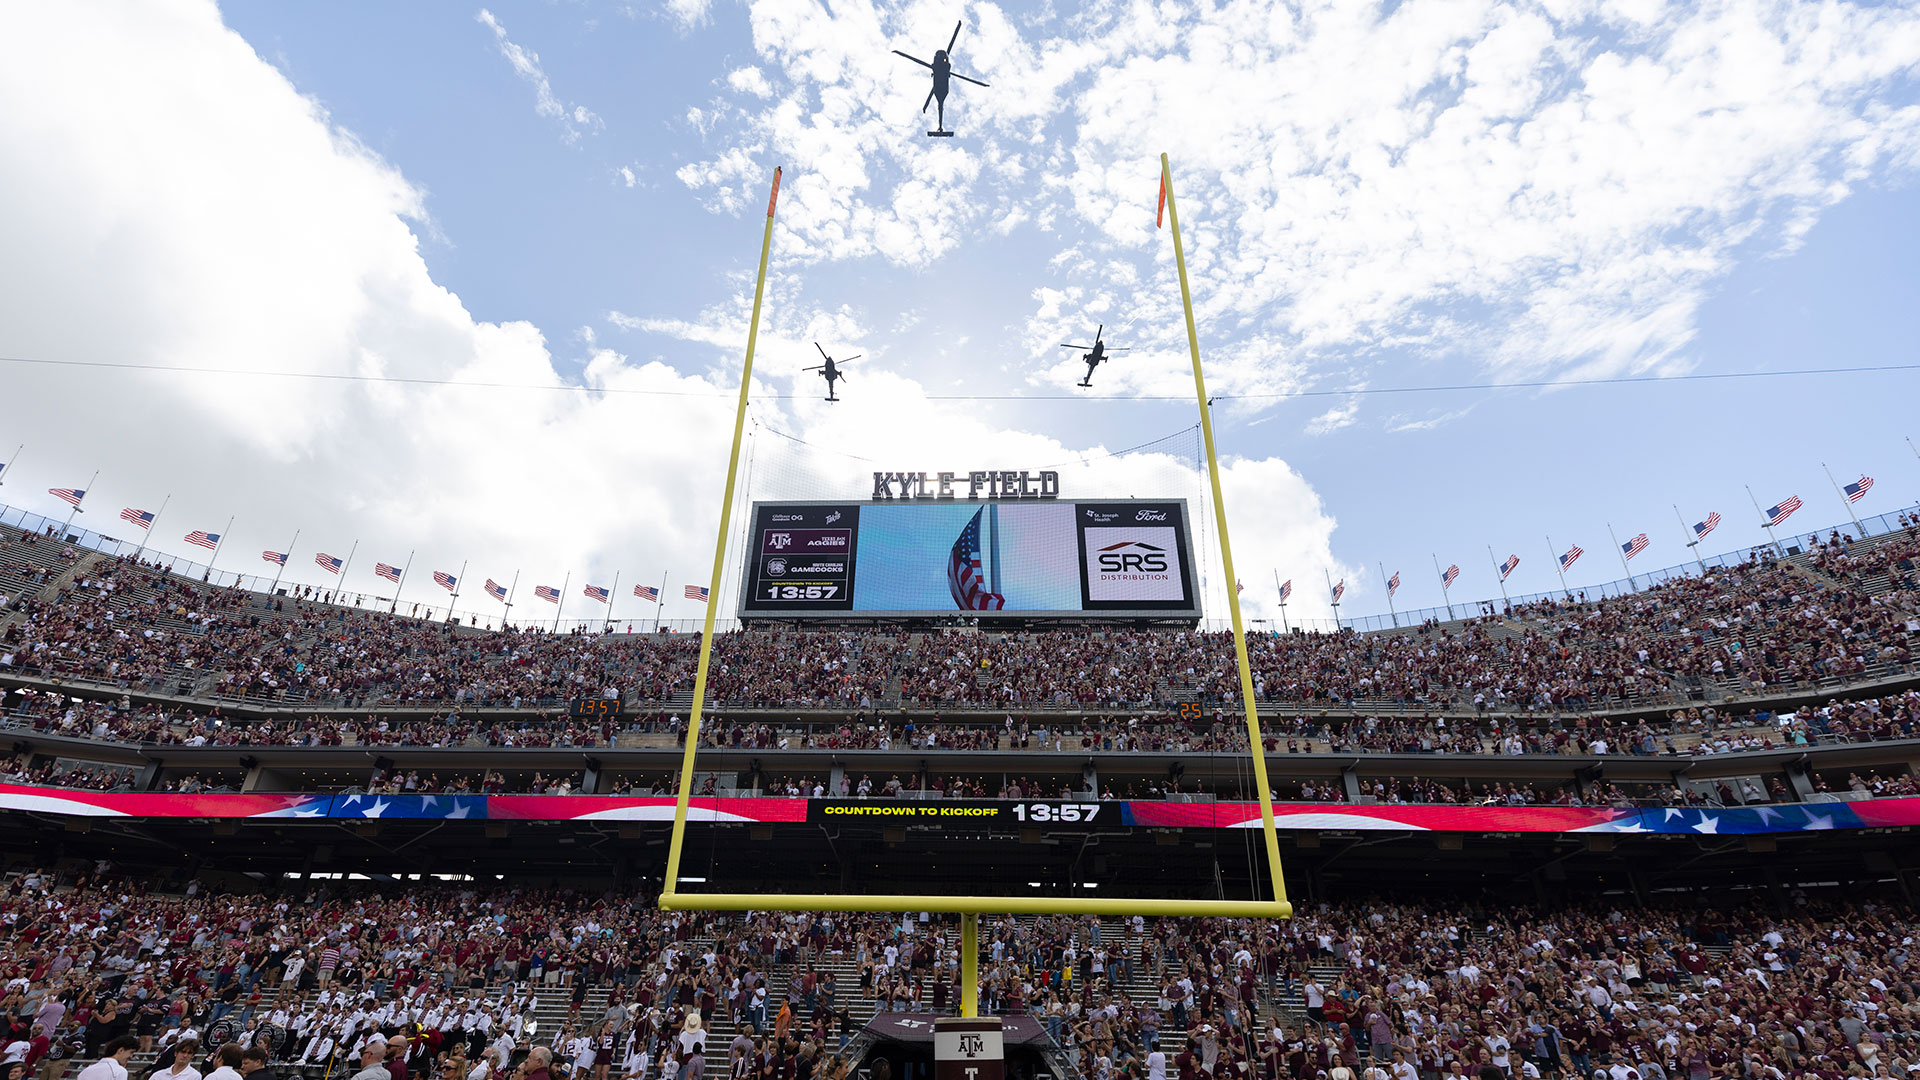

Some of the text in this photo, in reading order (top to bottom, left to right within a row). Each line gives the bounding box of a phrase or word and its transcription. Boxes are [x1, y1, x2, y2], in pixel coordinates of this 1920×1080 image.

[872, 471, 1059, 499] KYLE FIELD
[1135, 510, 1166, 521] Ford
[1098, 554, 1168, 572] SRS
[768, 586, 838, 599] 13:57
[580, 700, 620, 715] 13:57
[1180, 703, 1202, 718] 25
[824, 806, 998, 817] COUNTDOWN TO KICKOFF
[1012, 804, 1100, 822] 13:57
[563, 1045, 575, 1055] 12
[602, 1038, 613, 1050] 12
[1669, 1062, 1676, 1070] 2
